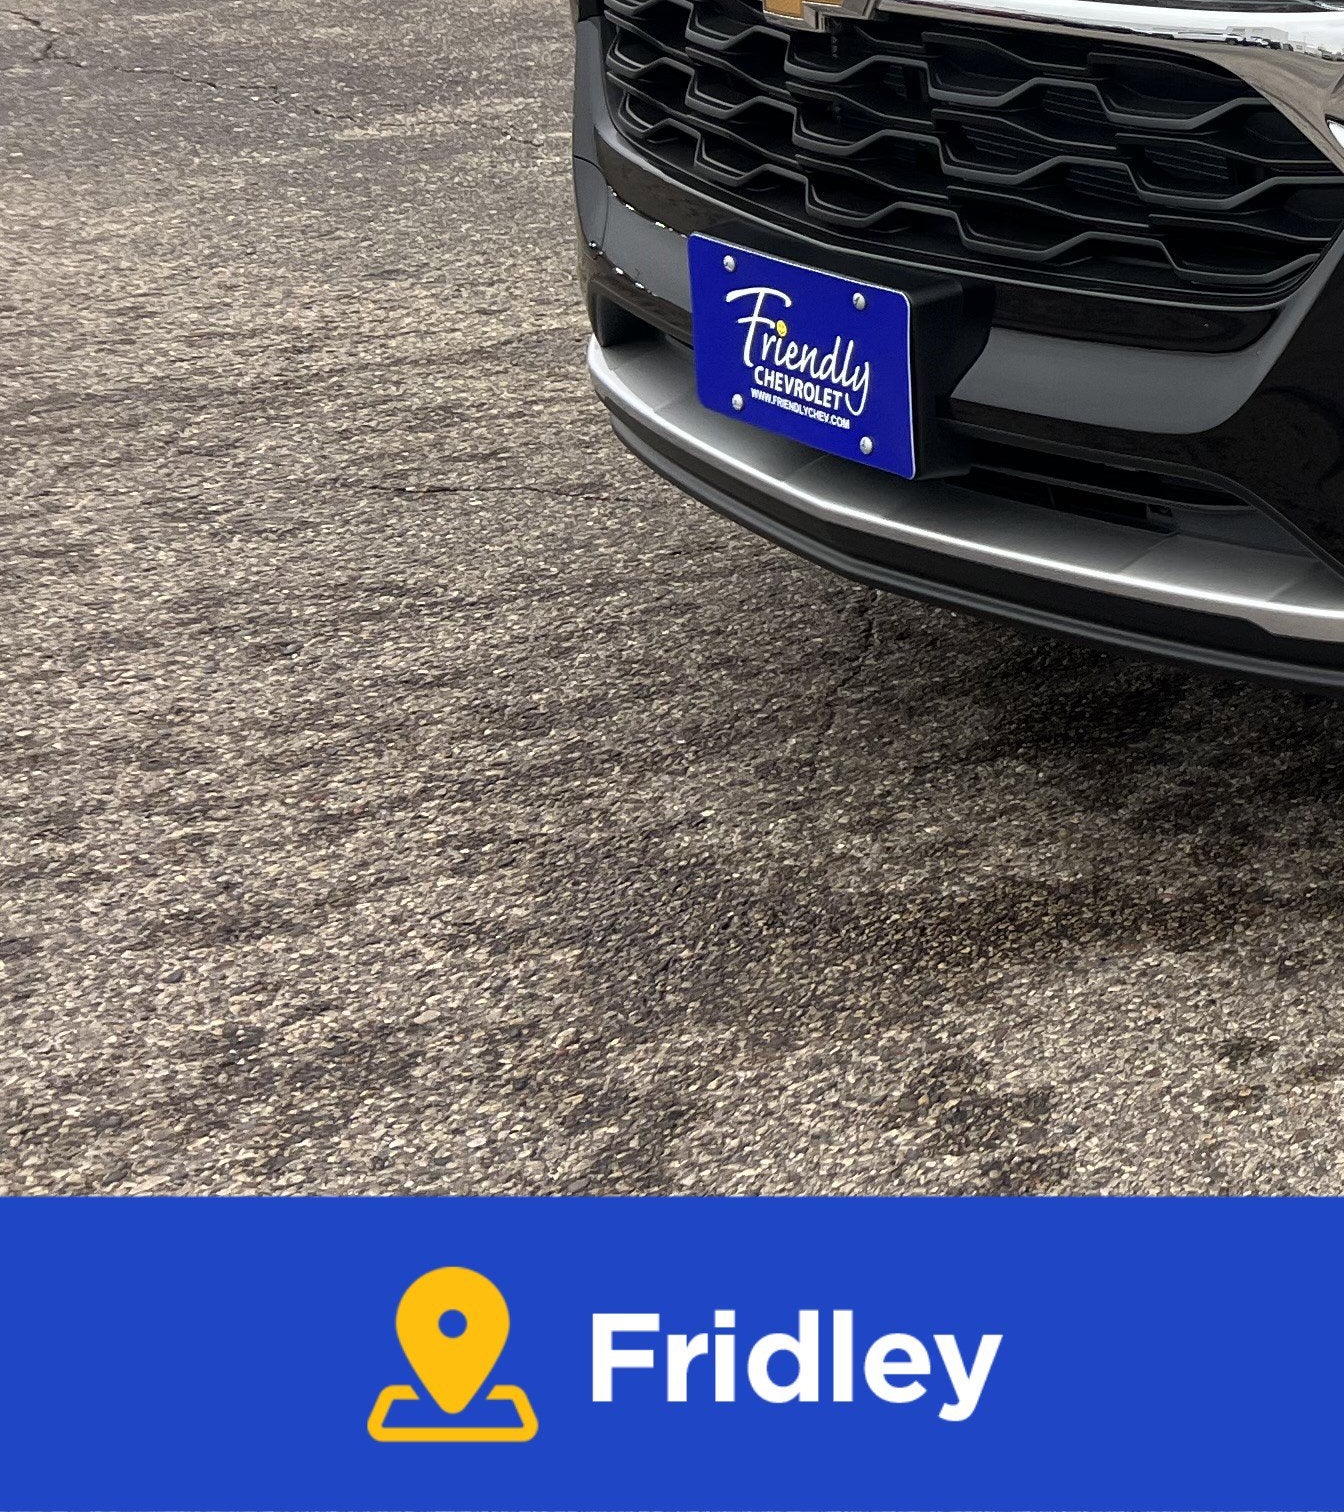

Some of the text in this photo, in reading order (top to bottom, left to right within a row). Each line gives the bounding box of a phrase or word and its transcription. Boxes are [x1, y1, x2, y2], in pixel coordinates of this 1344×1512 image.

[725, 286, 870, 417] Friendly
[750, 387, 851, 430] WWW.FRIENDLYCHEV.COM
[754, 365, 843, 411] CHEVROLET
